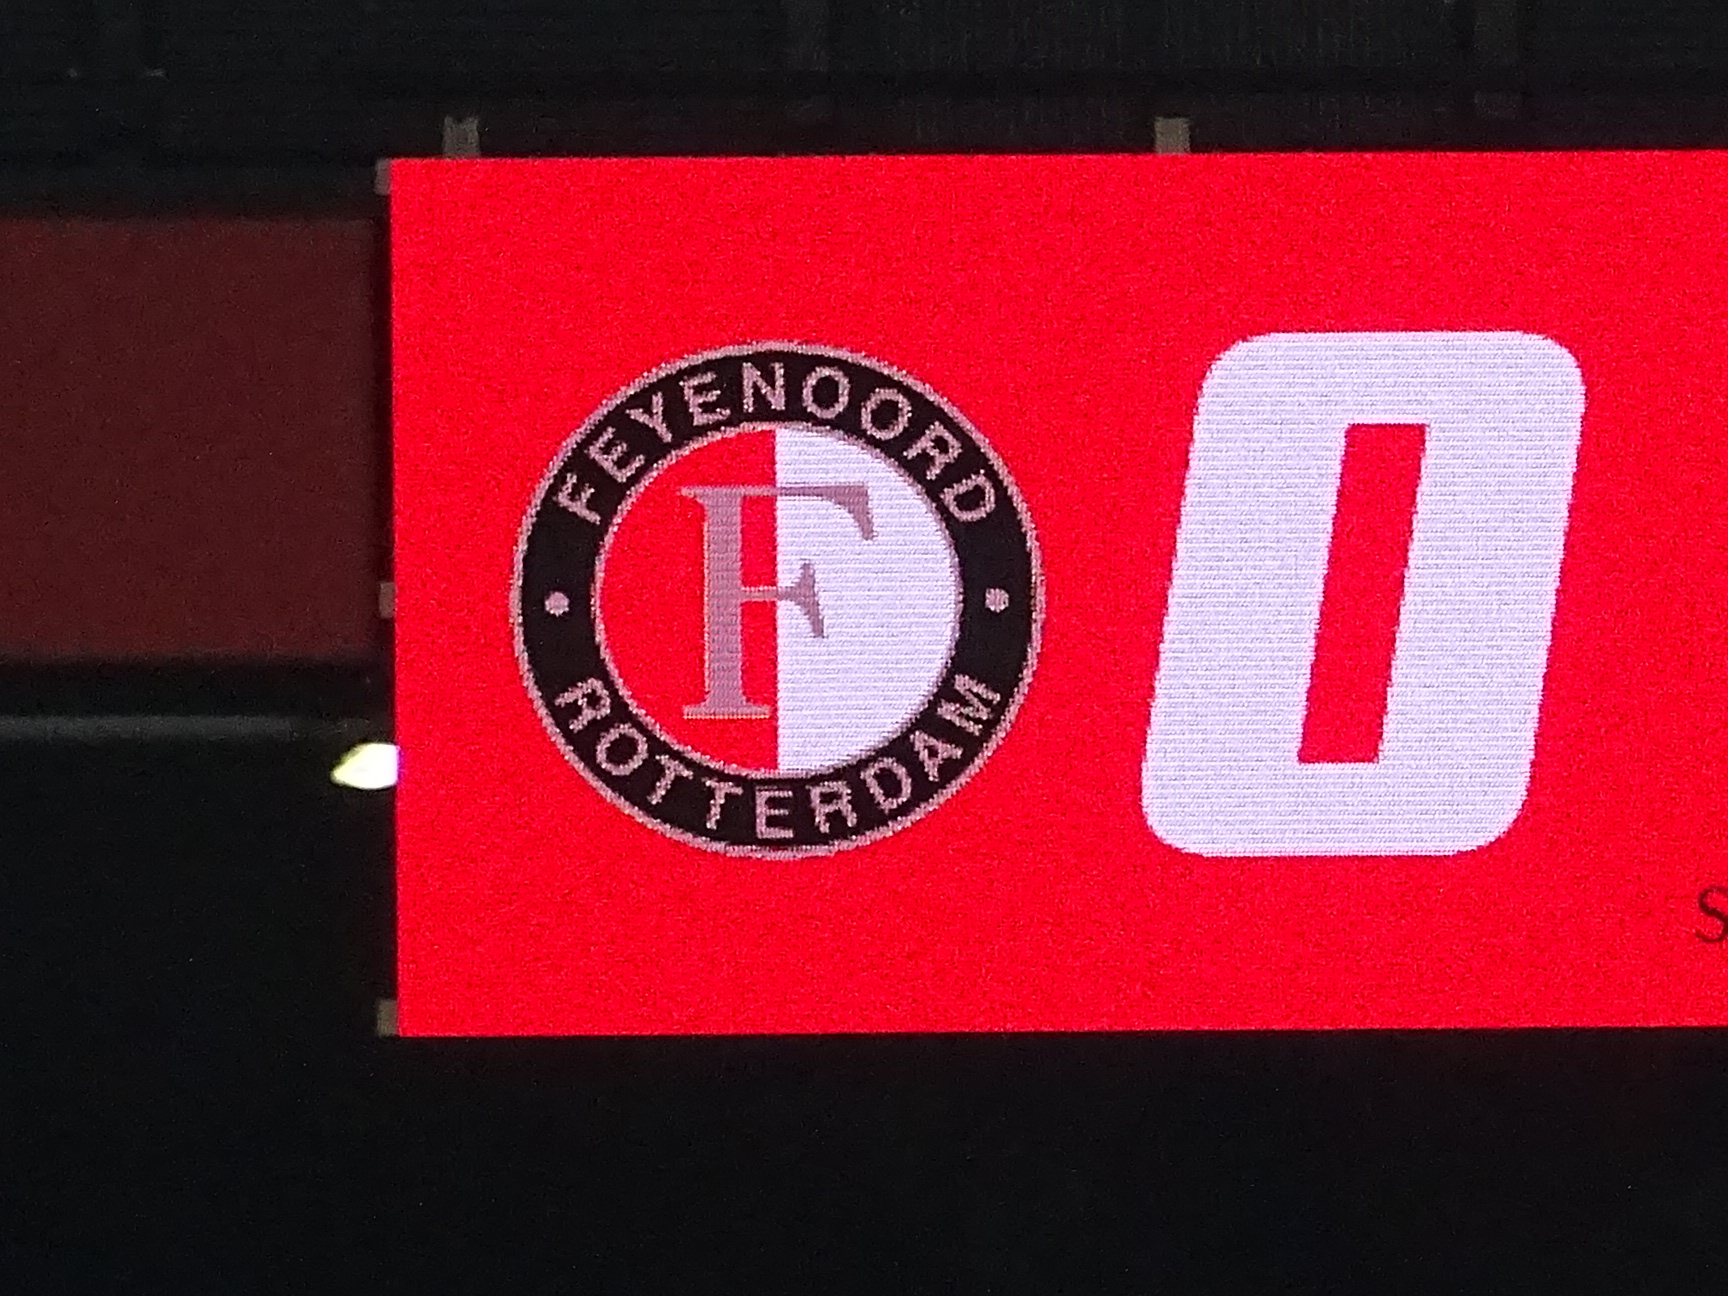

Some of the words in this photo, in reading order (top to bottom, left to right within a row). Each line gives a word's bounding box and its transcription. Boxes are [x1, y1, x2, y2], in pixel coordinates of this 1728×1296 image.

[554, 361, 998, 524] FEYENOORD
[682, 484, 876, 720] F
[1140, 331, 1586, 857] 0
[554, 673, 1001, 840] ROTTERDAM
